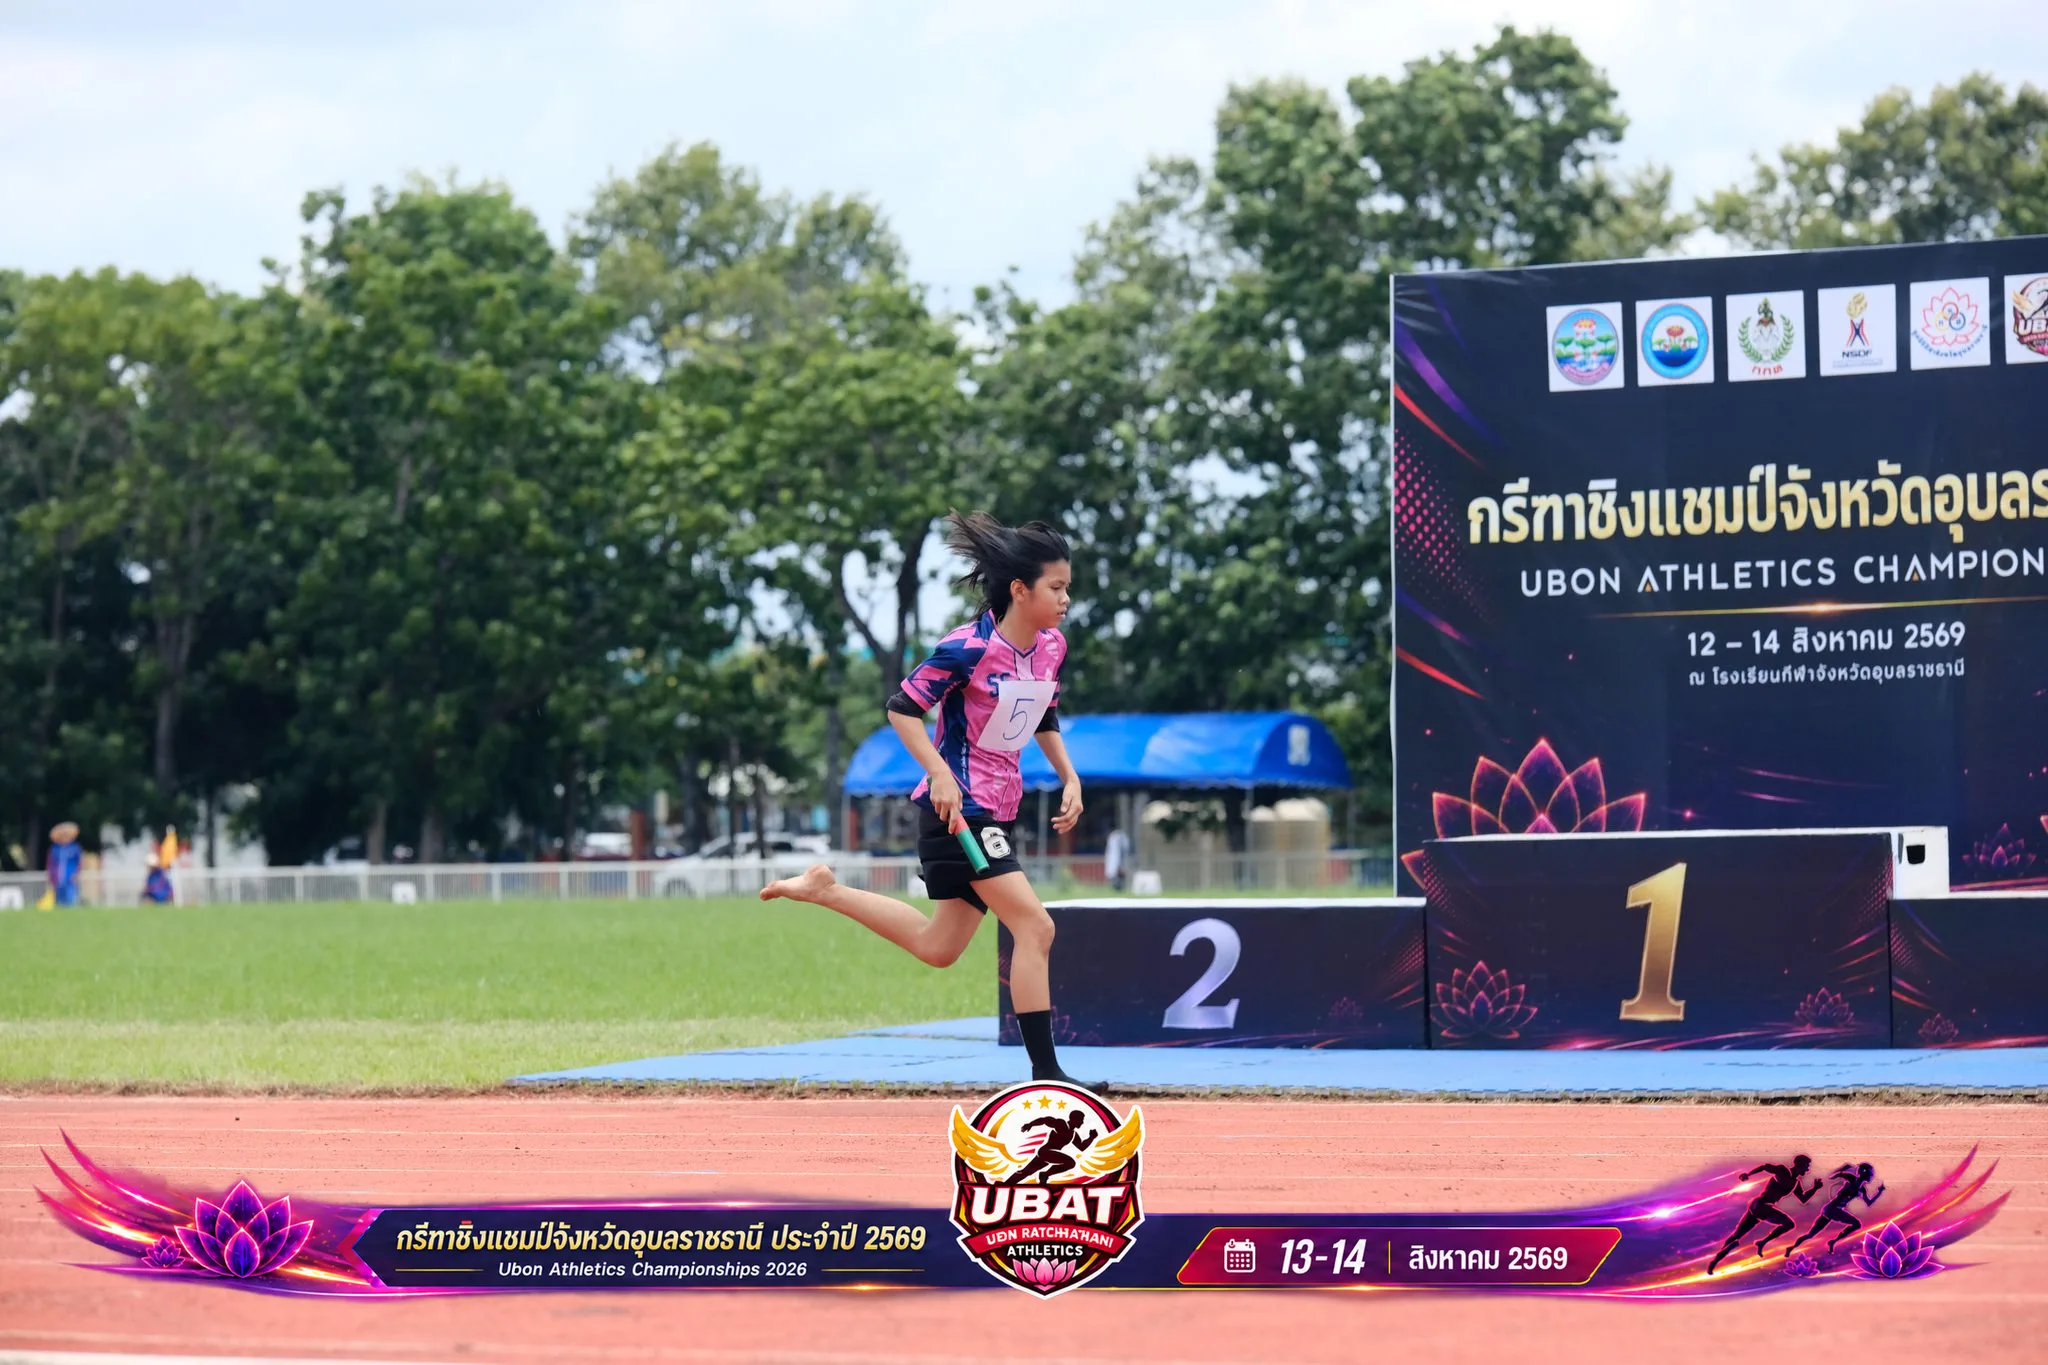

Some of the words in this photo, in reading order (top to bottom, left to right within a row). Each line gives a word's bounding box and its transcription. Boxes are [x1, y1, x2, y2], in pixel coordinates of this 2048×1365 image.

[1521, 566, 1621, 598] UBON
[1637, 556, 1836, 594] ATHLETICS
[1853, 546, 2045, 585] CHAMPION
[1687, 631, 1716, 657] 12
[1752, 629, 1780, 655] 14
[1792, 626, 1894, 654] สิงหาคม
[1903, 620, 1966, 650] 2569
[1002, 698, 1035, 741] 5
[1619, 862, 1687, 1021] 1
[1162, 917, 1242, 1029] 2
